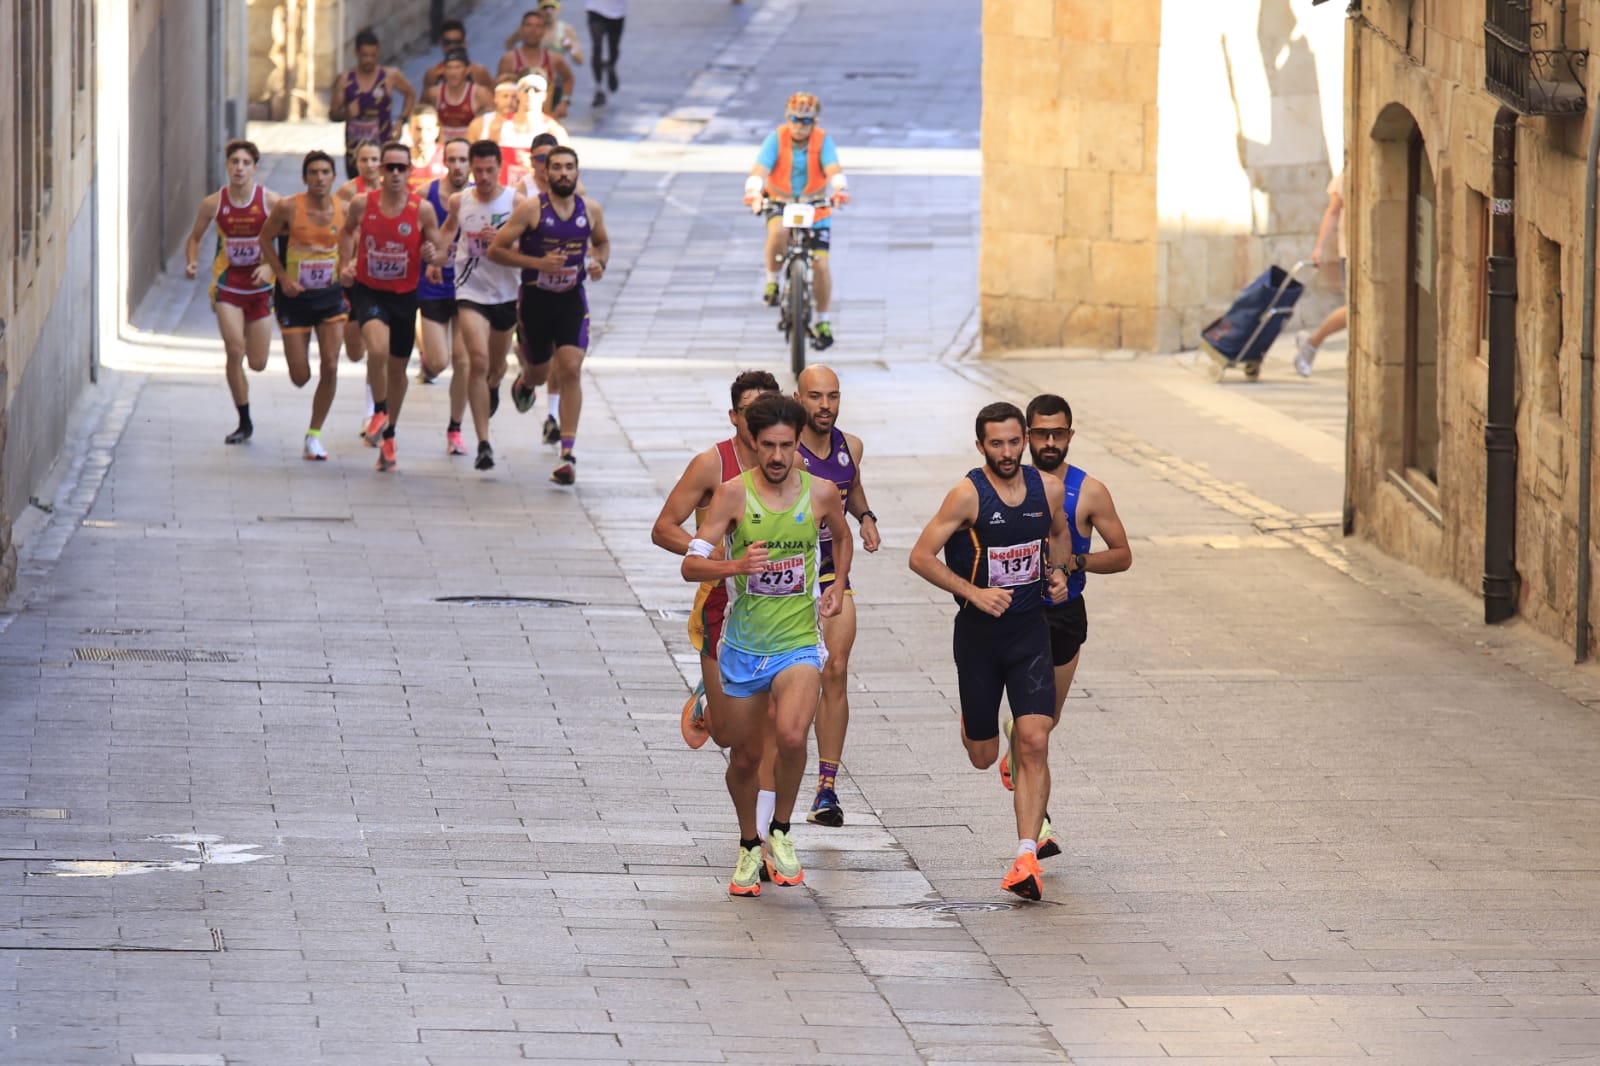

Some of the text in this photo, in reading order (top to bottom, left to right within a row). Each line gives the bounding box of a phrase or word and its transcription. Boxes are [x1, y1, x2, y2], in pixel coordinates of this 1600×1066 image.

[232, 247, 254, 257] 243
[376, 262, 399, 272] 324
[310, 270, 325, 281] 52
[548, 275, 569, 285] 134
[1002, 555, 1032, 574] 137
[760, 569, 794, 585] 473
